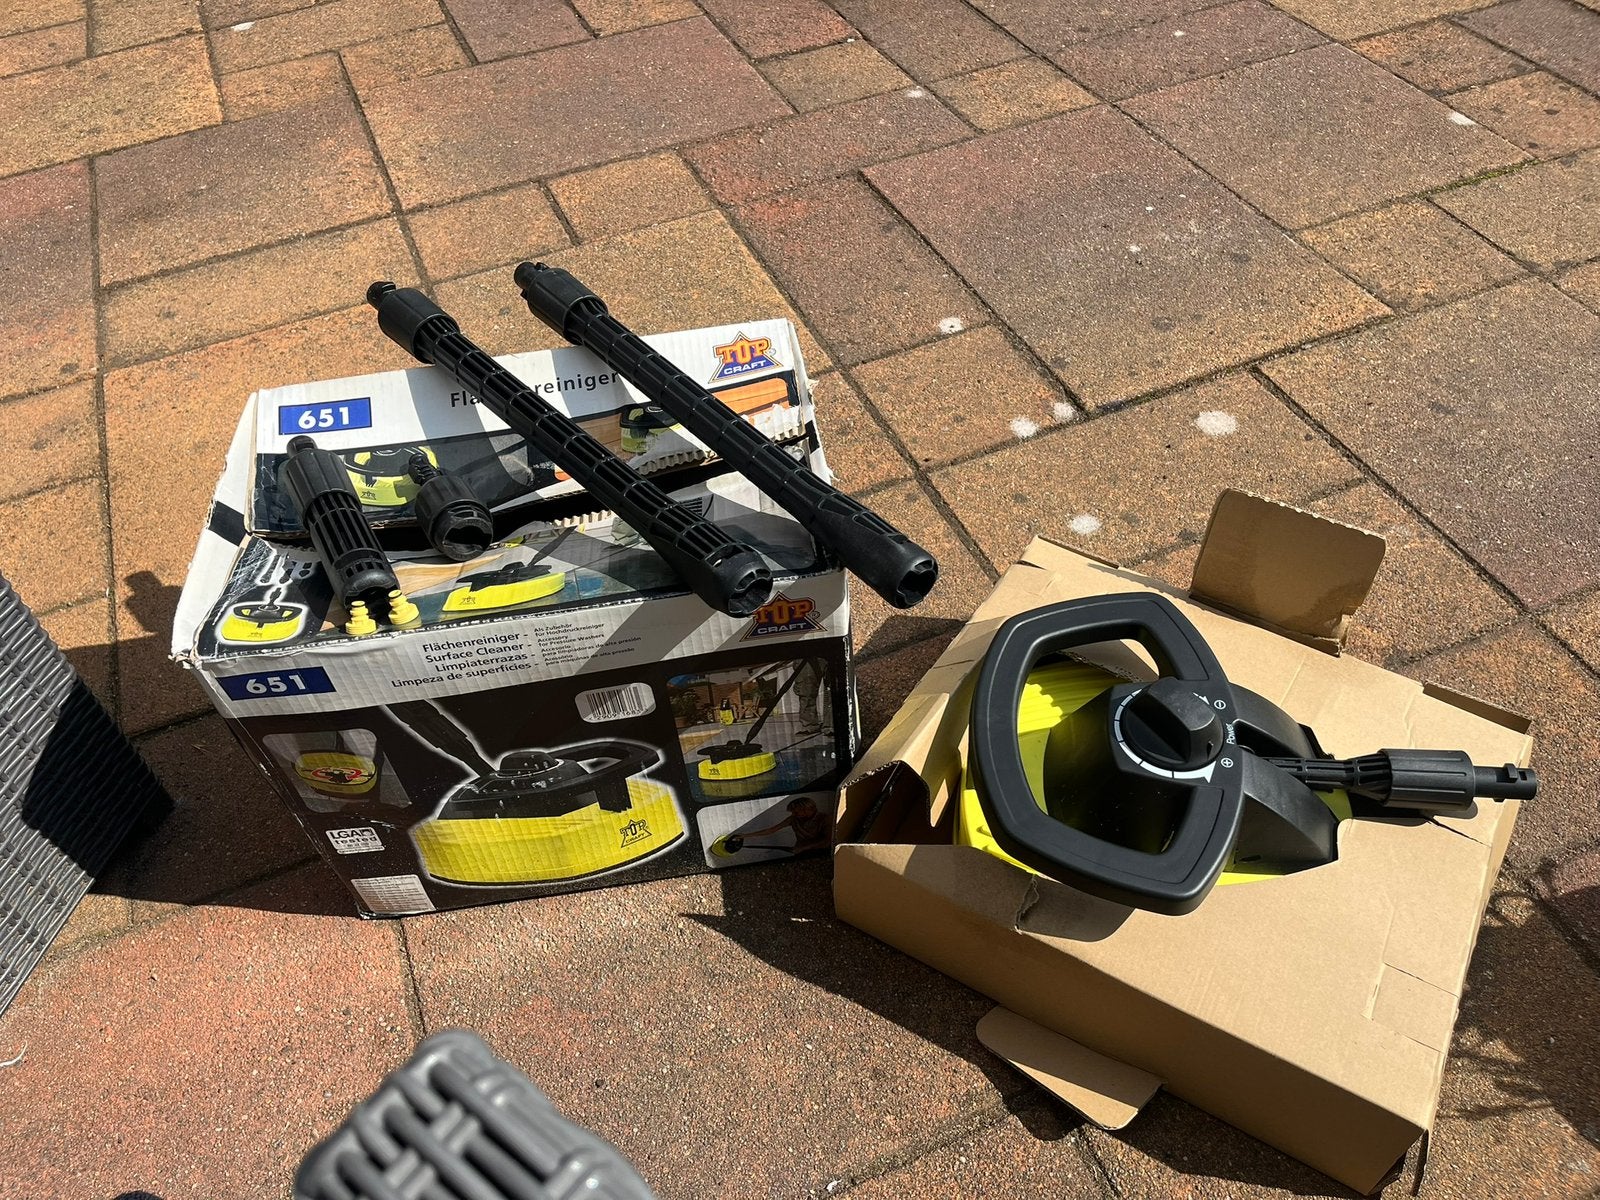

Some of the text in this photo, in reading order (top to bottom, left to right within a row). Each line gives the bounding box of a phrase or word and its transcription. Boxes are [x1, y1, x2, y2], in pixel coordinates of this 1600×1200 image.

[715, 338, 770, 364] TOP
[723, 359, 767, 375] CRAFT
[298, 406, 349, 430] 651
[754, 599, 814, 625] TOP
[757, 622, 807, 635] CRAFT
[422, 632, 520, 653] Flächenreiniger
[425, 649, 473, 663] Surface
[476, 642, 524, 656] Cleaner
[435, 652, 528, 673] Limpiaterrazas
[245, 674, 307, 695] 651
[391, 675, 444, 688] Limpeza
[446, 670, 463, 681] de
[329, 830, 362, 840] LGA
[620, 820, 647, 838] TOP
